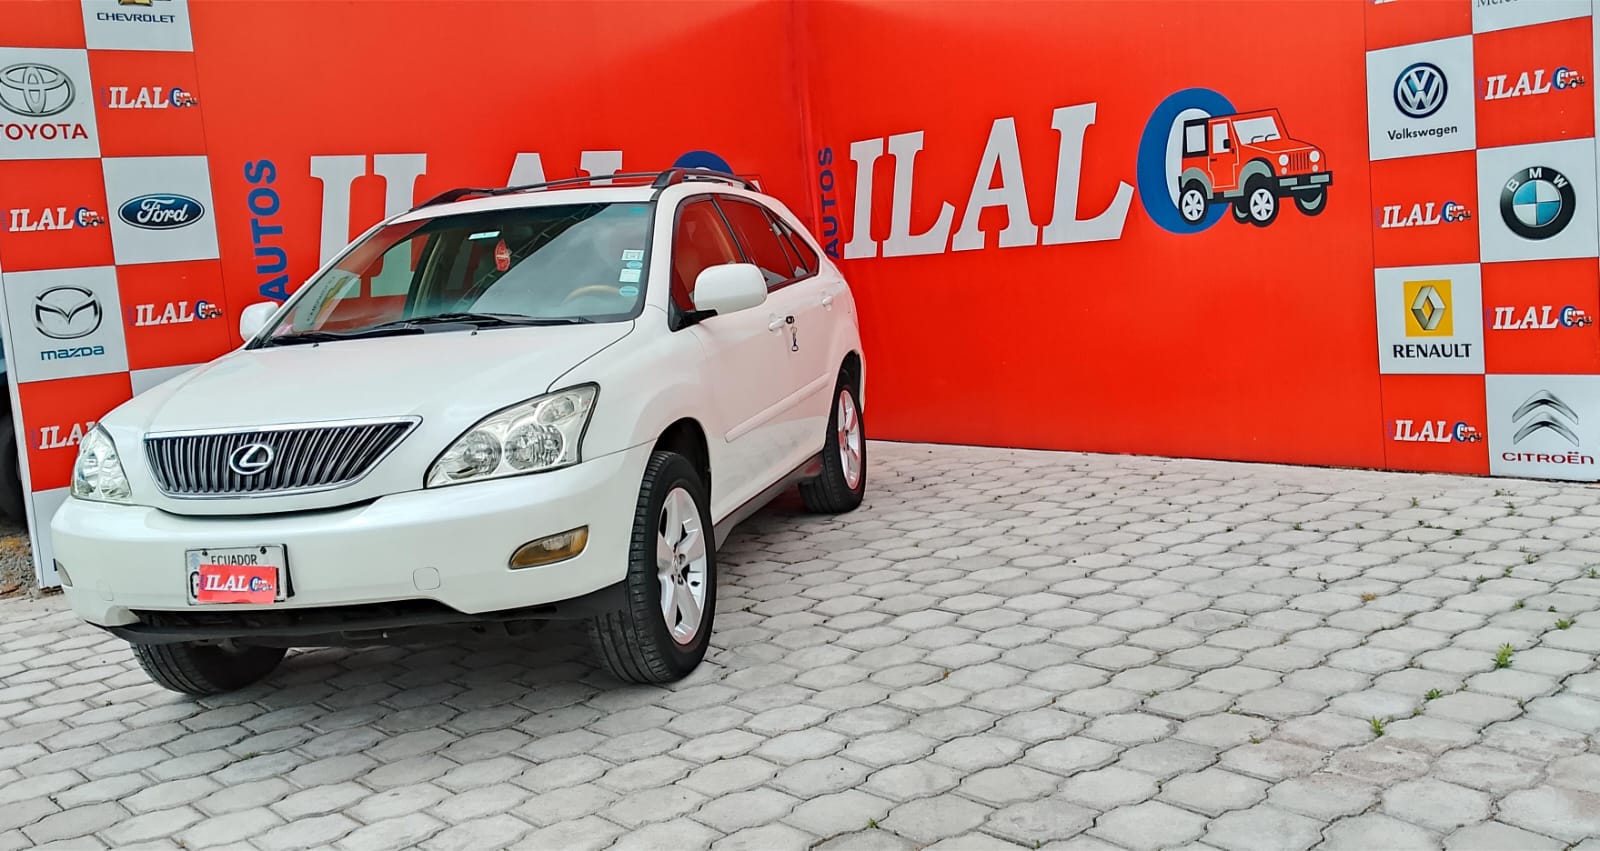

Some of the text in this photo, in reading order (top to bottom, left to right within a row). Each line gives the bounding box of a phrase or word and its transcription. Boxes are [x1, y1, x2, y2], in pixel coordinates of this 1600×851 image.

[97, 12, 176, 24] CHEVROLET
[1387, 125, 1458, 141] Volkswagen
[1505, 167, 1568, 193] BMW
[136, 198, 190, 223] Ford
[818, 147, 840, 259] AUTOS
[244, 159, 292, 301] AUTOS
[40, 345, 105, 361] mazda
[1392, 343, 1473, 359] RENAULT
[211, 554, 258, 566] ECUADOR
